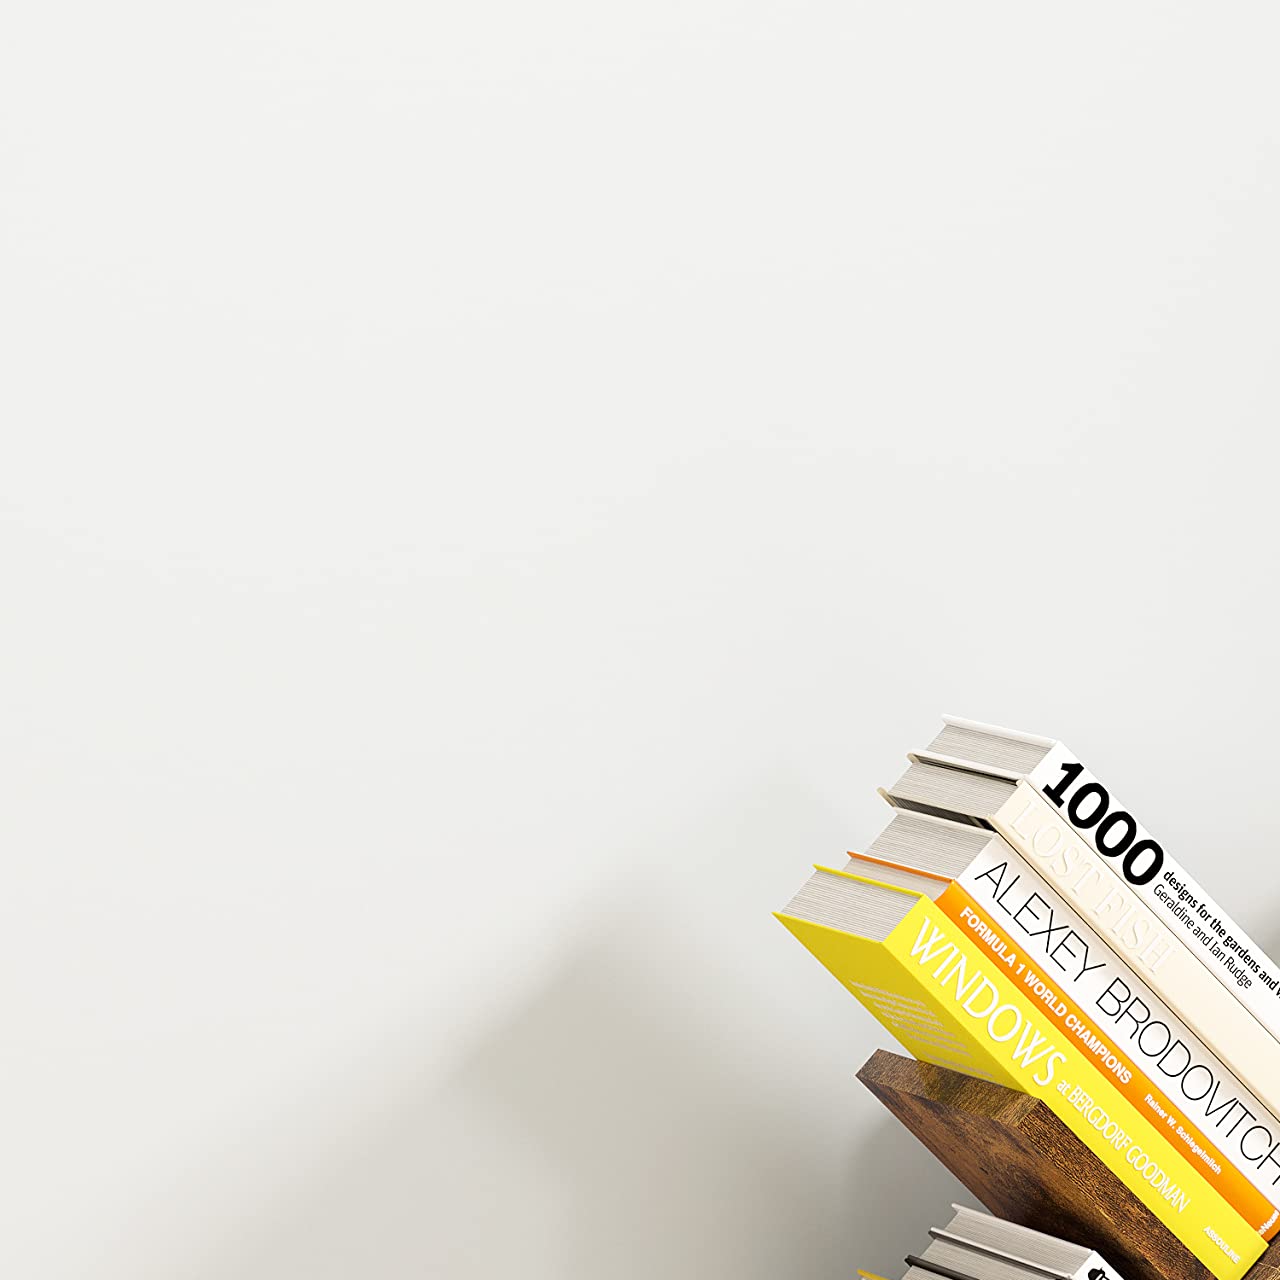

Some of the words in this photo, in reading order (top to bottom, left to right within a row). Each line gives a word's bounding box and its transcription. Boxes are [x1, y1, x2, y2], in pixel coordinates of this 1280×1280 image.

[974, 854, 1106, 989] ALEXEY
[1005, 797, 1105, 900] LOST
[1090, 885, 1179, 976] FISH
[1037, 754, 1173, 892] 1000
[1160, 868, 1201, 910] designs
[1195, 903, 1215, 923] for
[1208, 916, 1229, 938] the
[1221, 932, 1263, 975] gardens
[1257, 967, 1280, 991] and
[1151, 882, 1197, 930] Geraldine
[1191, 923, 1214, 946] and
[1208, 940, 1228, 961] Ian
[1220, 955, 1255, 991] Rudge
[898, 913, 1070, 1090] WINDOWS
[1054, 1077, 1073, 1095] at
[1064, 1084, 1132, 1154] BERGDORF
[1122, 1142, 1192, 1214] GOODMAN
[958, 905, 1019, 967] FORMULA
[1013, 961, 1027, 975] 1
[1021, 969, 1069, 1018] WORLD
[1062, 1011, 1134, 1085] CHAMPIONS
[1143, 1093, 1169, 1119] Rainer
[1165, 1115, 1179, 1129] W.
[1202, 1224, 1241, 1265] ASSOULINE
